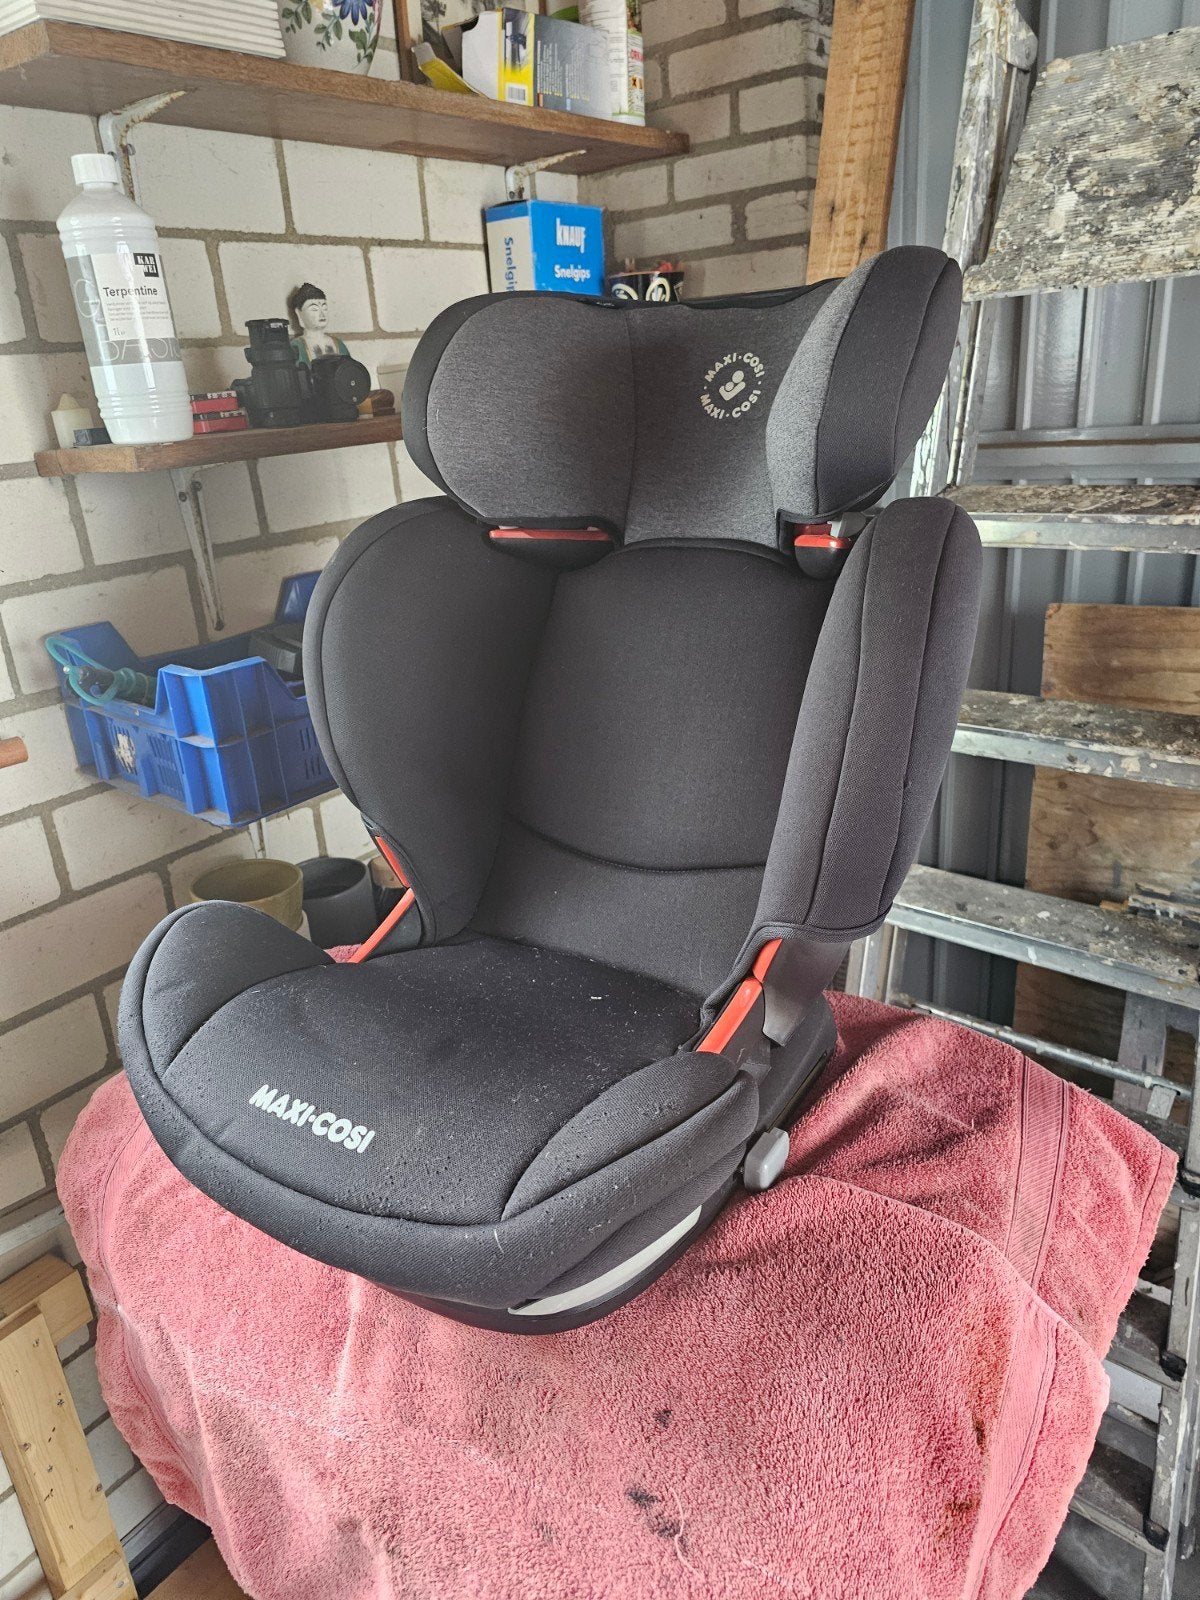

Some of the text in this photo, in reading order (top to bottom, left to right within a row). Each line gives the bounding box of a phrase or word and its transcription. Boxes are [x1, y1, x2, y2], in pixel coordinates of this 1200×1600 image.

[556, 217, 586, 253] KNAUF
[554, 264, 591, 282] Snelgips
[102, 285, 158, 299] Terpentine
